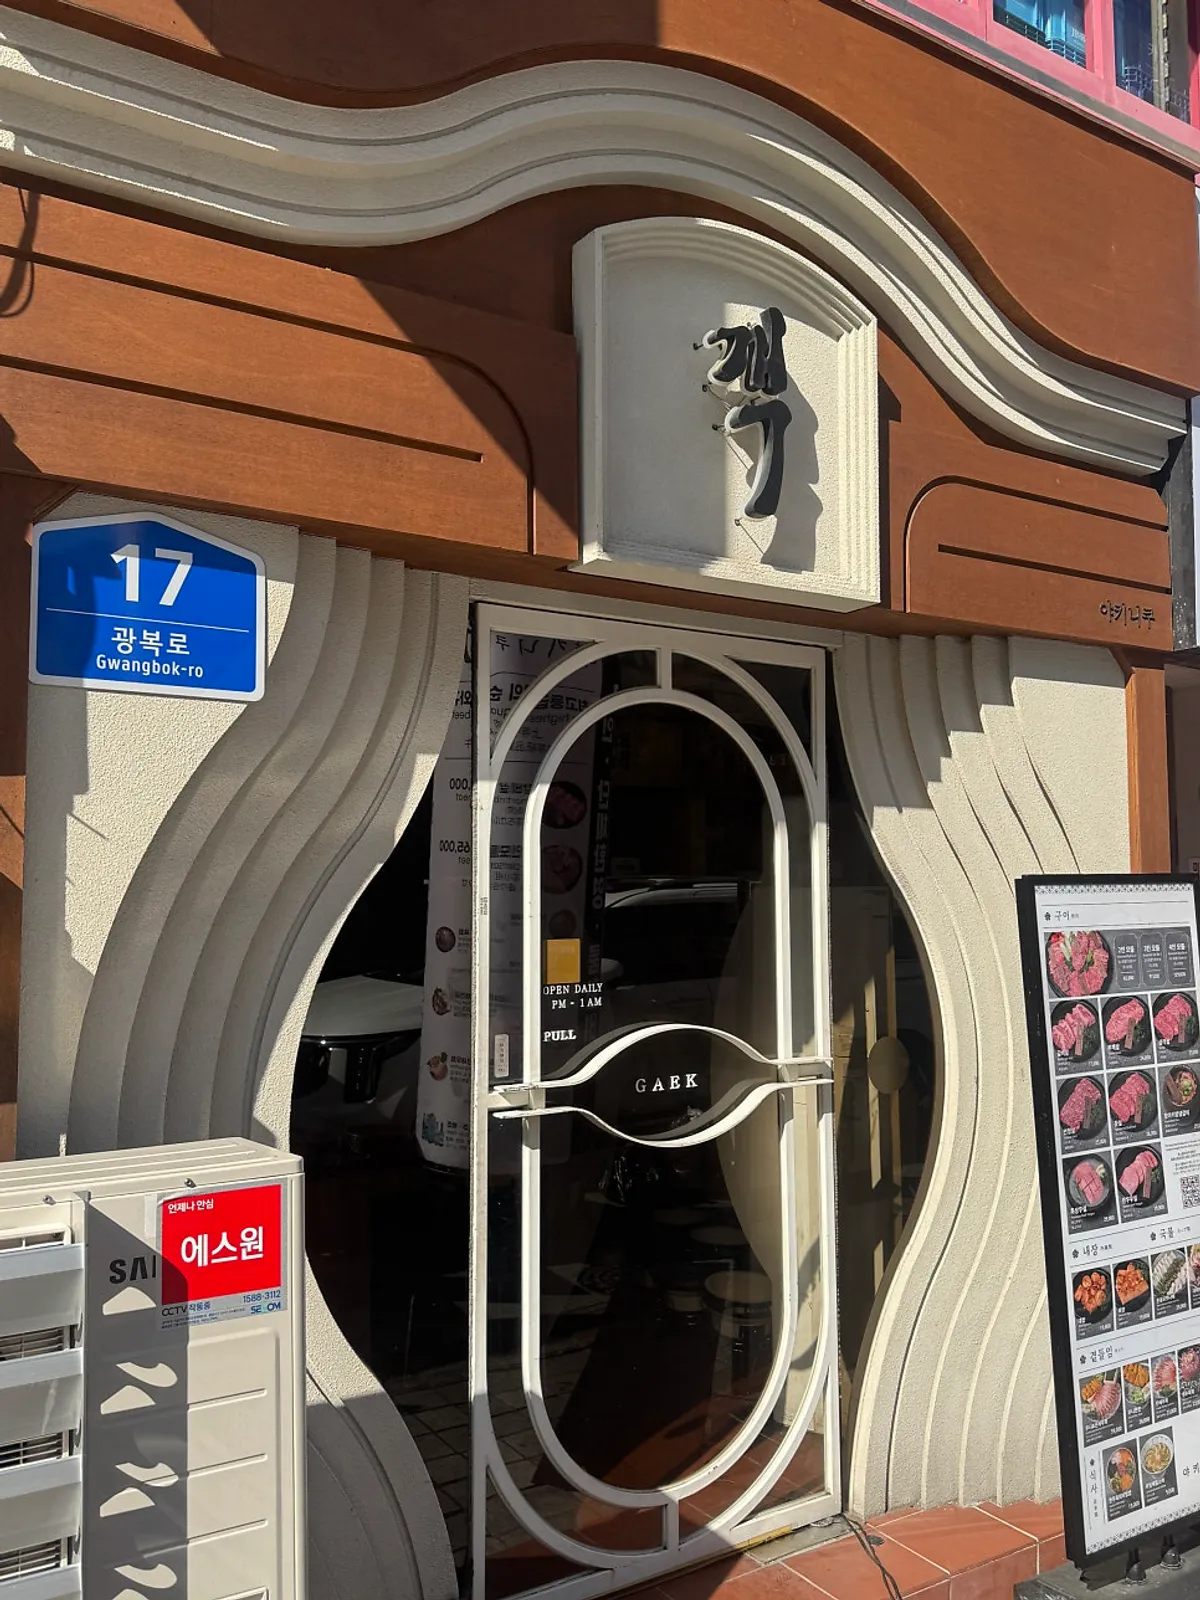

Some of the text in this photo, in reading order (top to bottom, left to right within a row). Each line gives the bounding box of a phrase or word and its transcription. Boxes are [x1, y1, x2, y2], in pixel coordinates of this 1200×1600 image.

[110, 544, 194, 606] 17
[111, 626, 190, 658] 광복로
[96, 653, 203, 679] Gwangbok-ro
[542, 982, 604, 995] OPEN DAILY
[542, 1028, 577, 1043] PULL
[634, 1072, 699, 1094] GAEK
[167, 1198, 215, 1215] 언제나 안심
[180, 1226, 265, 1268] 에스원
[161, 1305, 188, 1317] CCTV
